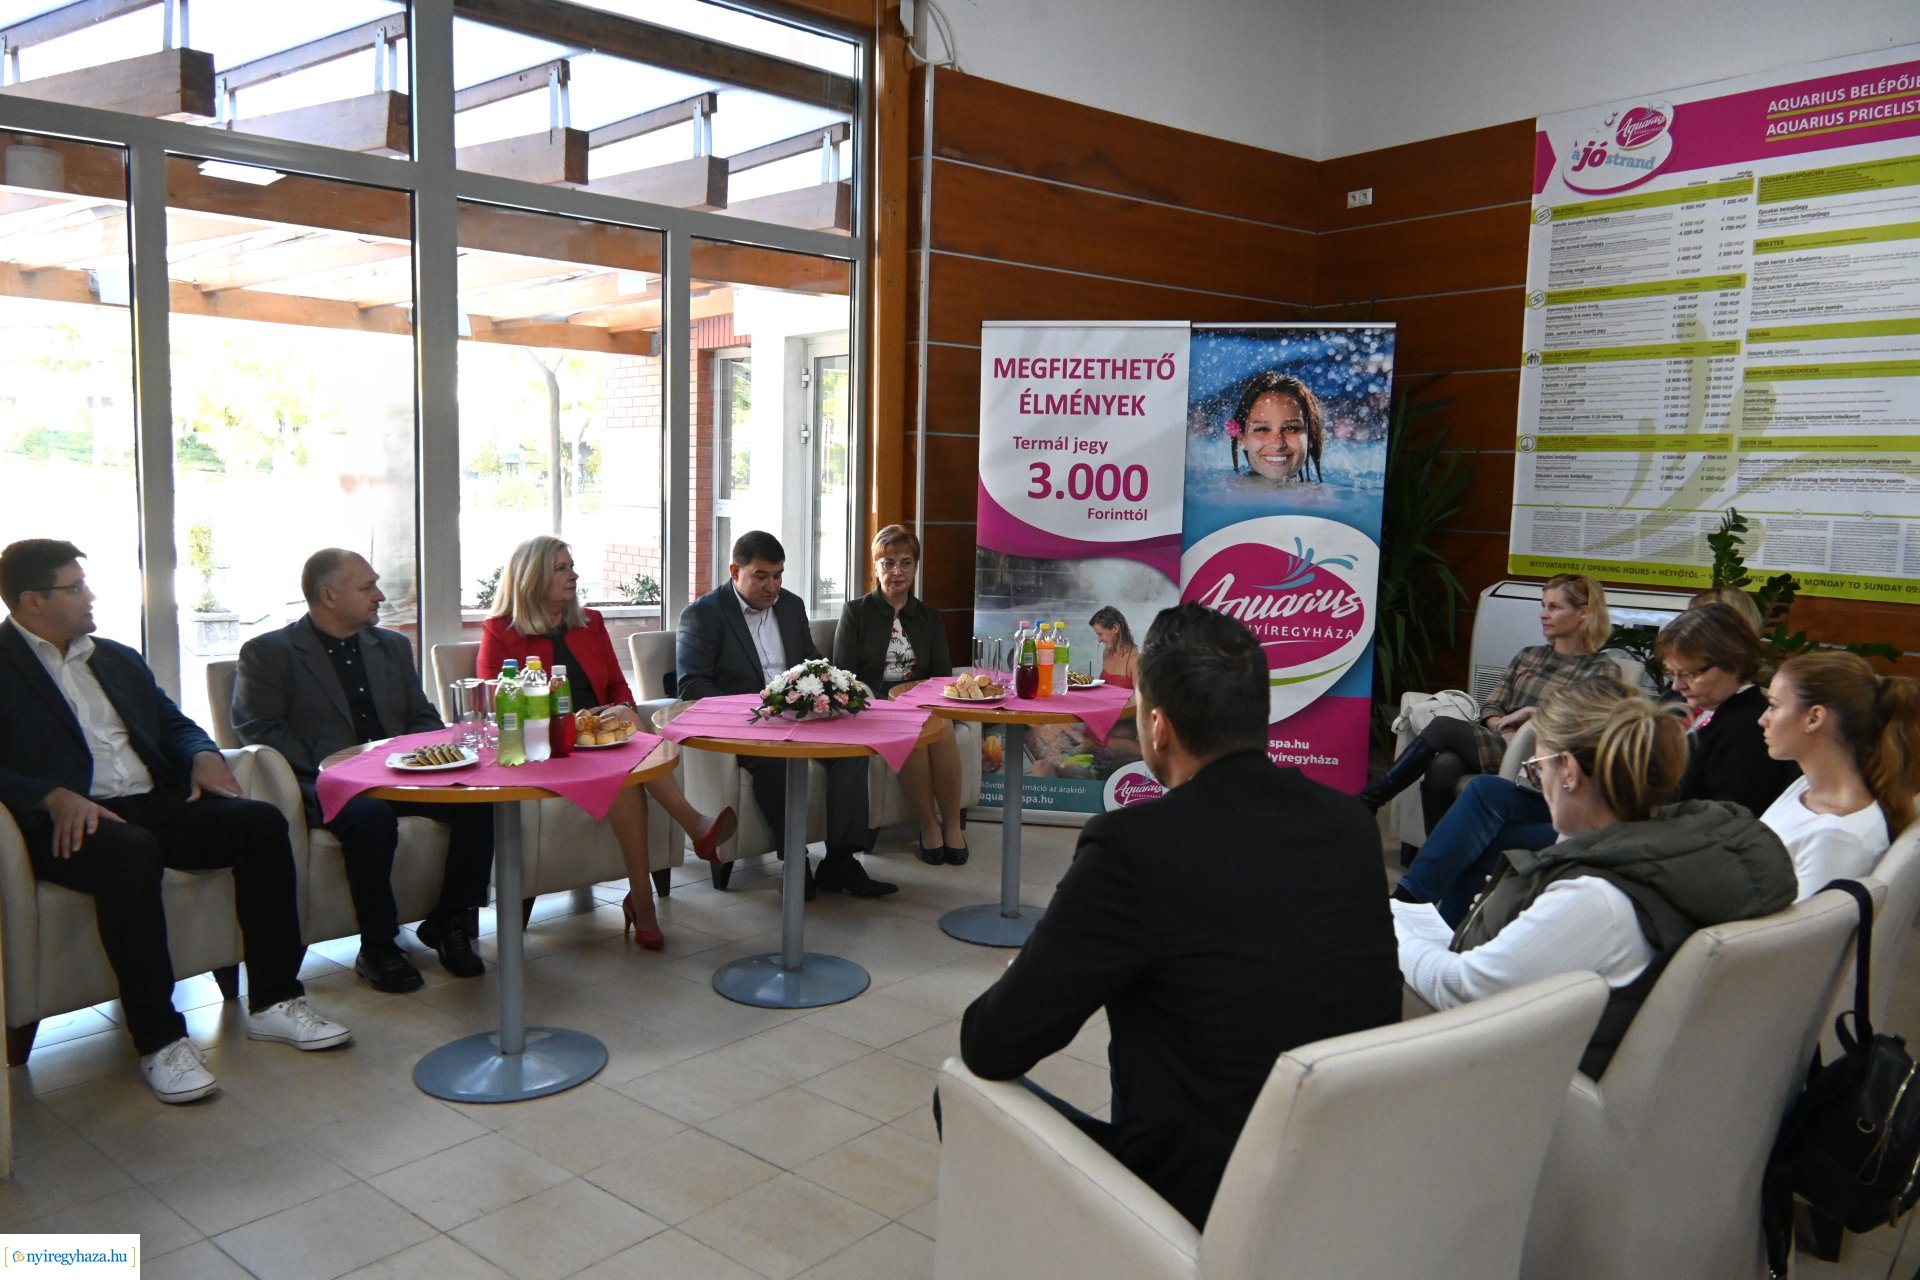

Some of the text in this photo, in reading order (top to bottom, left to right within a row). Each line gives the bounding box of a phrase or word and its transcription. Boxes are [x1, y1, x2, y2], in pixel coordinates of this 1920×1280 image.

[1768, 89, 1846, 113] AQUARIUS
[1616, 115, 1665, 144] Aquarius
[1766, 112, 1844, 136] AQUARIUS
[1571, 141, 1656, 172] a jó strand
[993, 352, 1176, 380] MEGFIZETHETŐ
[1019, 388, 1146, 416] ÉLMÉNYEK
[1012, 436, 1109, 455] Termál jegy
[1027, 462, 1149, 502] 3.000
[1087, 507, 1148, 521] Forinttól
[1529, 560, 1580, 571] NYITVATARTÁS
[1587, 564, 1621, 574] OPENING
[1623, 567, 1650, 576] HOURS
[1658, 565, 1699, 579] HÉTFŐTŐL
[1804, 579, 1845, 589] MONDAY
[1848, 581, 1861, 590] TO
[1863, 582, 1903, 593] SUNDAY
[1249, 622, 1355, 639] YÍREGYHÁZA
[1269, 739, 1310, 749] spa.hu
[1115, 780, 1162, 804] Aquarius
